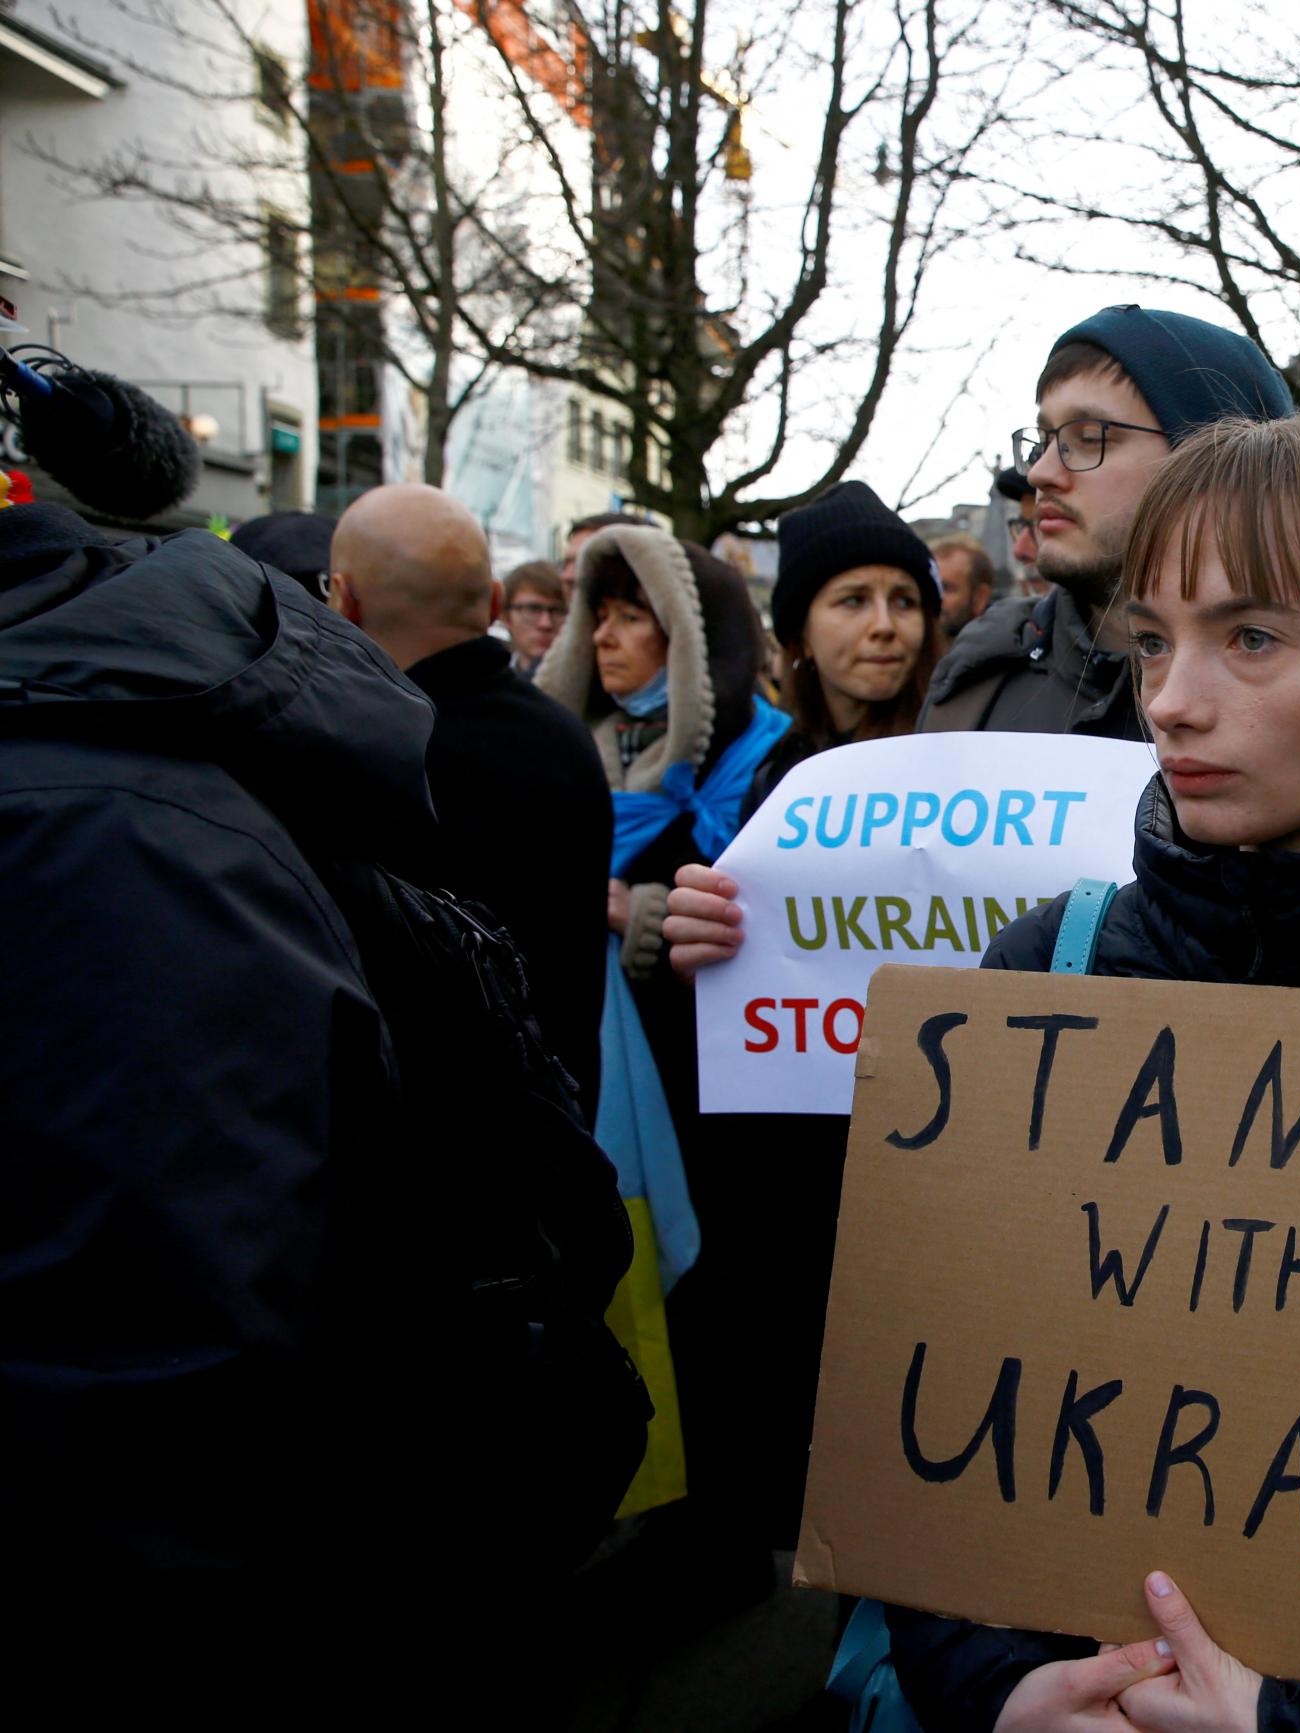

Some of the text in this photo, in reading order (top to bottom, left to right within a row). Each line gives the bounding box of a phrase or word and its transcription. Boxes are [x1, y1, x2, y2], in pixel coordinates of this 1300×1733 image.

[777, 789, 1087, 848] SUPPORT
[784, 896, 1056, 952] UKRAIN
[744, 997, 865, 1055] STO
